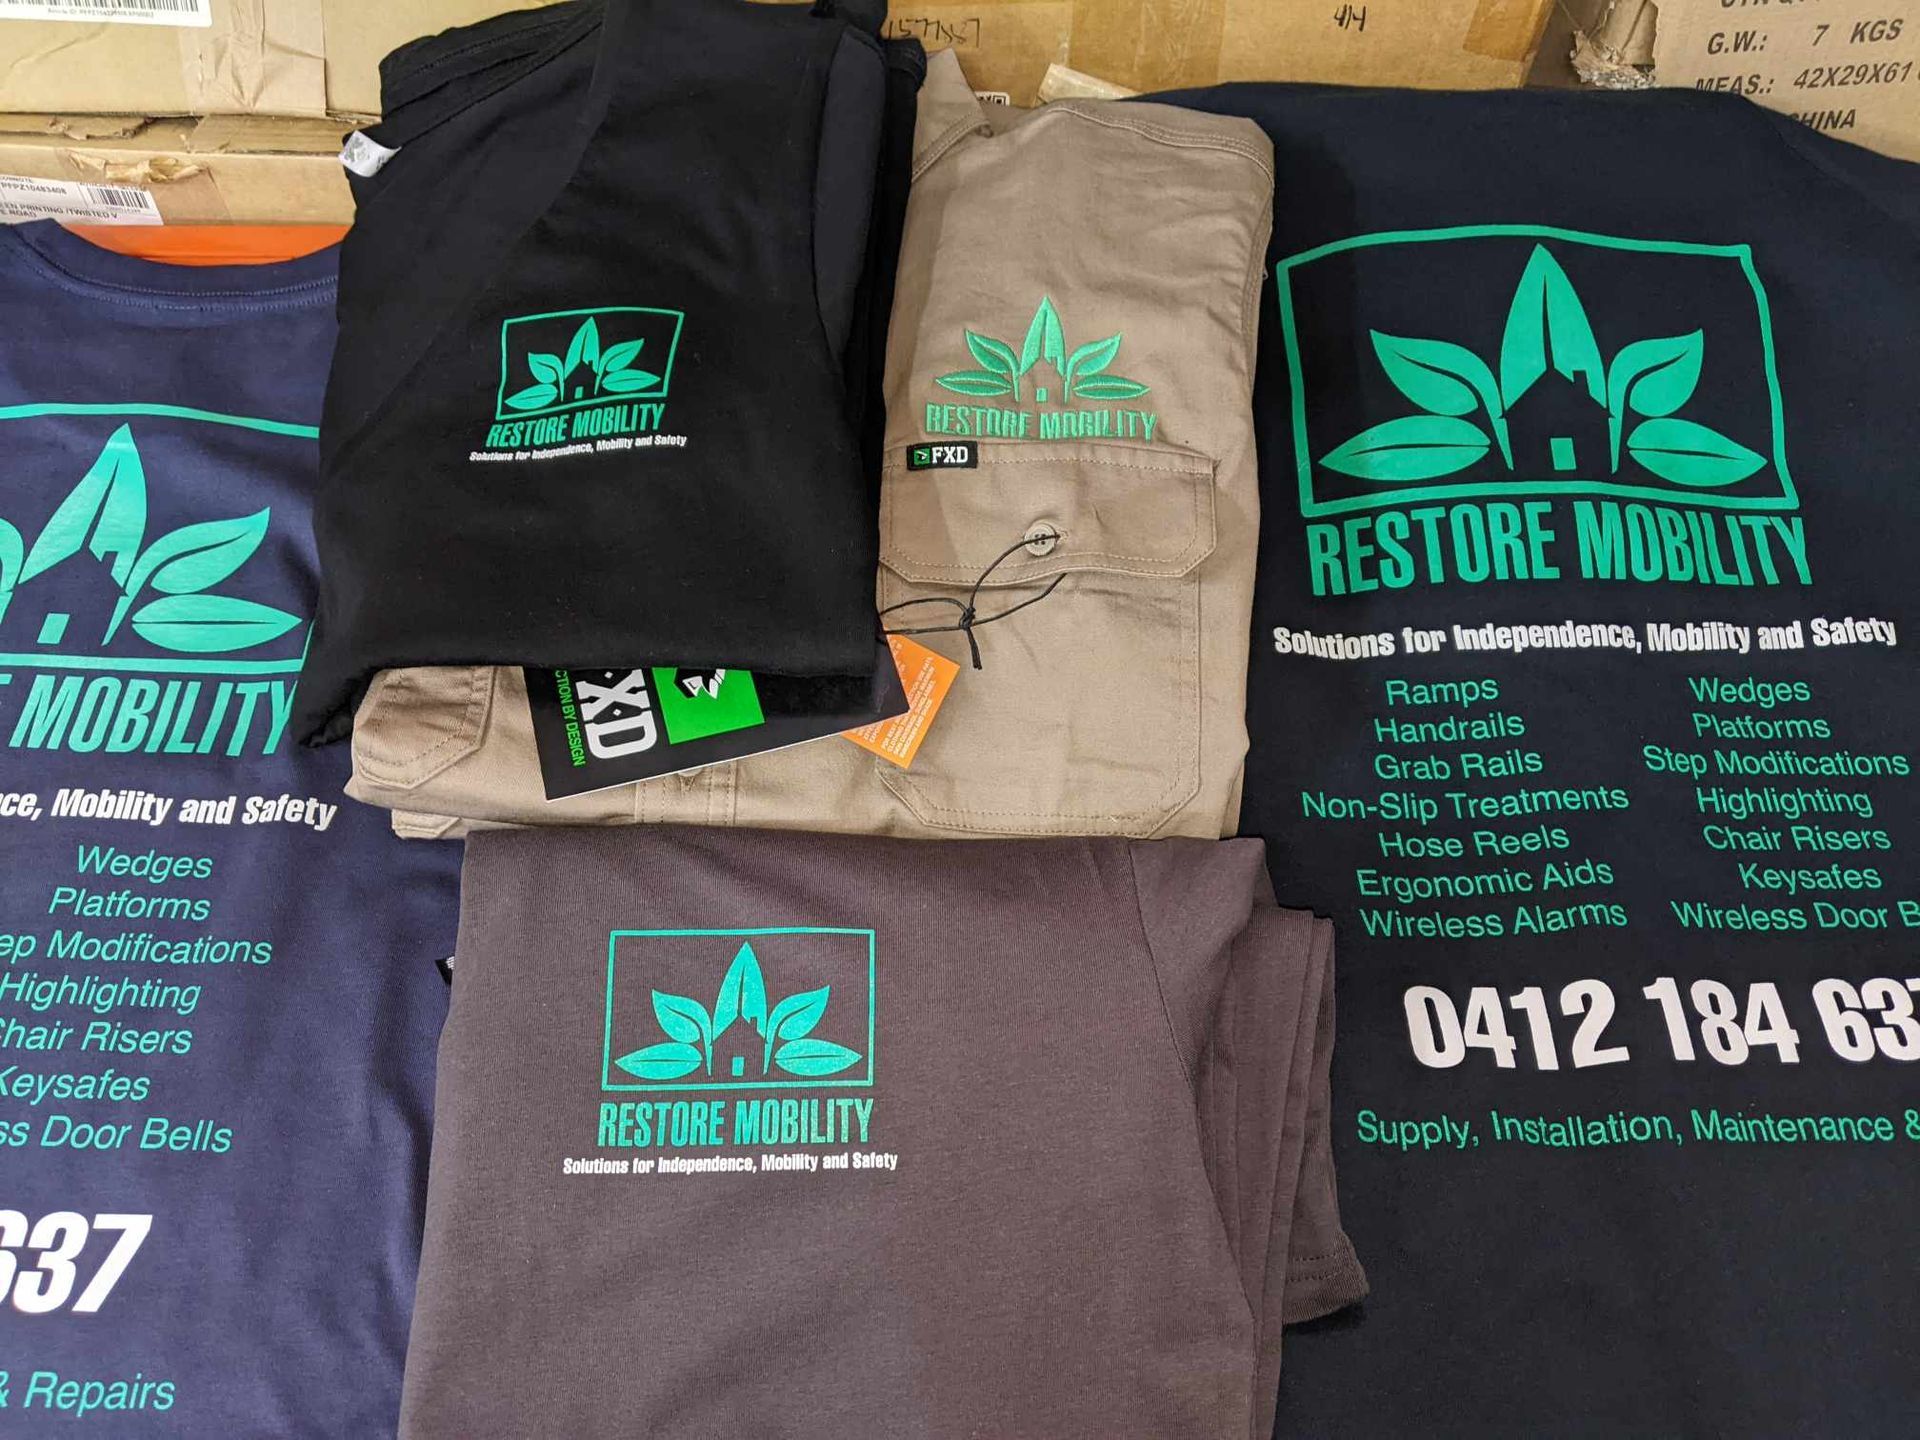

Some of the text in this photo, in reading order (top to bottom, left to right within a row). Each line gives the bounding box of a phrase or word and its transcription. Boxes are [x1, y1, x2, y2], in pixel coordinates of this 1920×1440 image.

[1707, 18, 1904, 55] G.W.: 7 KGS
[1696, 61, 1913, 95] MEAS.: 42X29X61
[485, 403, 666, 448] RESTORE MOBILITY
[926, 403, 1157, 442] RESTORE MOBILITY
[469, 433, 688, 462] Solutions for Independence, Mobility and Safety
[932, 446, 969, 464] FXD
[1306, 500, 1813, 596] RESTORE MOBILITY
[1273, 617, 1898, 660] Solutions for Independence, Mobility and Safety
[1386, 679, 1499, 708] Ramps
[1688, 676, 1811, 709] Wedges
[9, 674, 297, 756] MOBILITY
[562, 704, 577, 720] BY
[1374, 712, 1525, 743] Handrails
[1692, 712, 1832, 740] Platforms
[566, 722, 586, 767] DESIGN
[1642, 744, 1911, 780] Step Modifications
[1375, 748, 1543, 780] Grab Rails
[0, 789, 337, 831] ce, Mobility and Safety
[1302, 785, 1629, 825] Non-Slip Treatments
[1696, 786, 1874, 820] Highlighting
[1378, 824, 1570, 858] Hose Reels
[1703, 824, 1892, 851] Chair Risers
[77, 845, 213, 883] Wedges
[1357, 857, 1615, 904] Ergonomic Aids
[1737, 863, 1882, 895] Keysafes
[49, 887, 211, 920] Platforms
[1360, 903, 1628, 939] Wireless Alarms
[1670, 900, 1807, 930] Wireless
[1813, 901, 1888, 928] Door
[47, 930, 272, 964] Modifications
[0, 972, 201, 1014] Highlighting
[0, 1018, 193, 1054] hair Risers
[1404, 976, 1920, 1070] 0412 184 63
[40, 1115, 132, 1149] Door
[140, 1118, 233, 1153] Bells
[597, 1098, 874, 1147] RESTORE MOBILITY
[1357, 1110, 1479, 1151] Supply,
[1492, 1110, 1684, 1148] Installation,
[1693, 1109, 1894, 1142] Maintenance
[563, 1151, 898, 1174] Solutions for Independence, Mobility and Safety
[23, 1371, 175, 1417] Repairs
